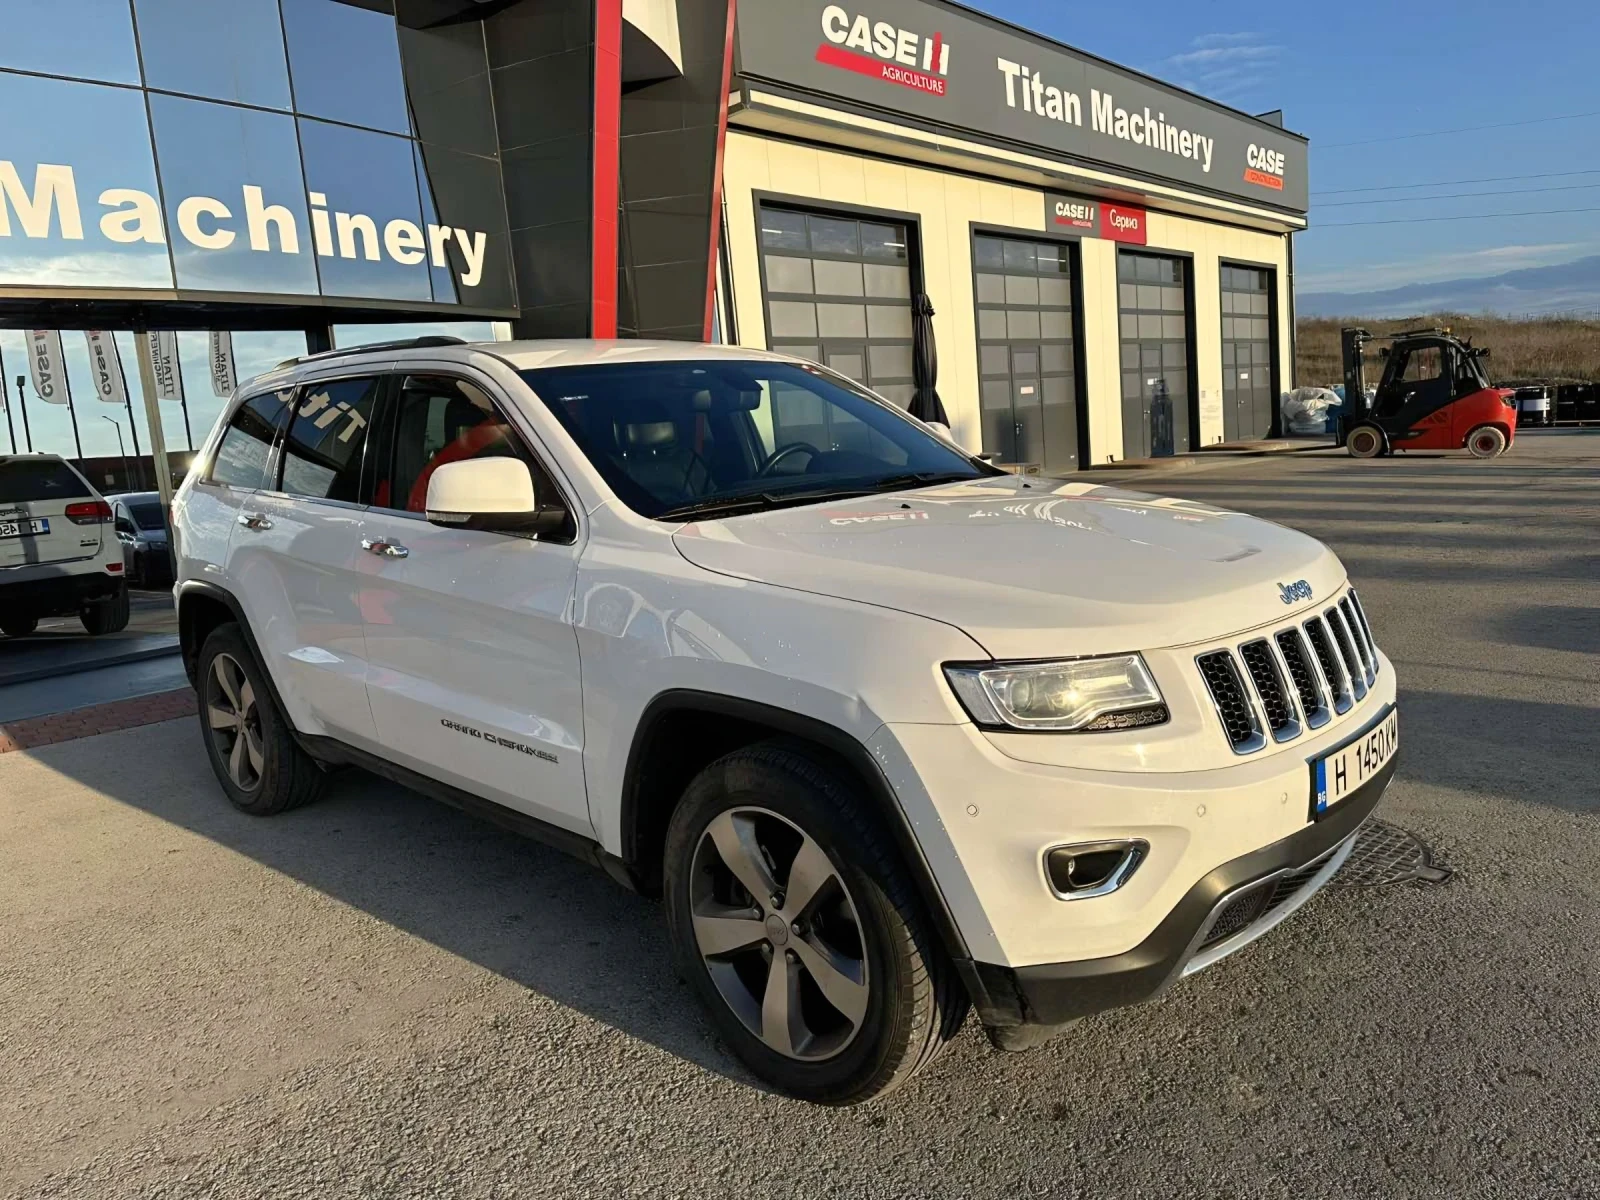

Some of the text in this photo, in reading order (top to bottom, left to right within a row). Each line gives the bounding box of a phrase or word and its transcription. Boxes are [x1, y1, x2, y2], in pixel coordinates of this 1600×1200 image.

[821, 5, 919, 67] CASE
[882, 65, 944, 94] AGRICULTURE
[997, 57, 1214, 173] Titan Machinery
[1246, 143, 1285, 176] CASE
[0, 159, 487, 287] Machinery
[1055, 202, 1085, 219] CASE
[1276, 579, 1313, 605] Jeep
[1317, 790, 1327, 805] BG
